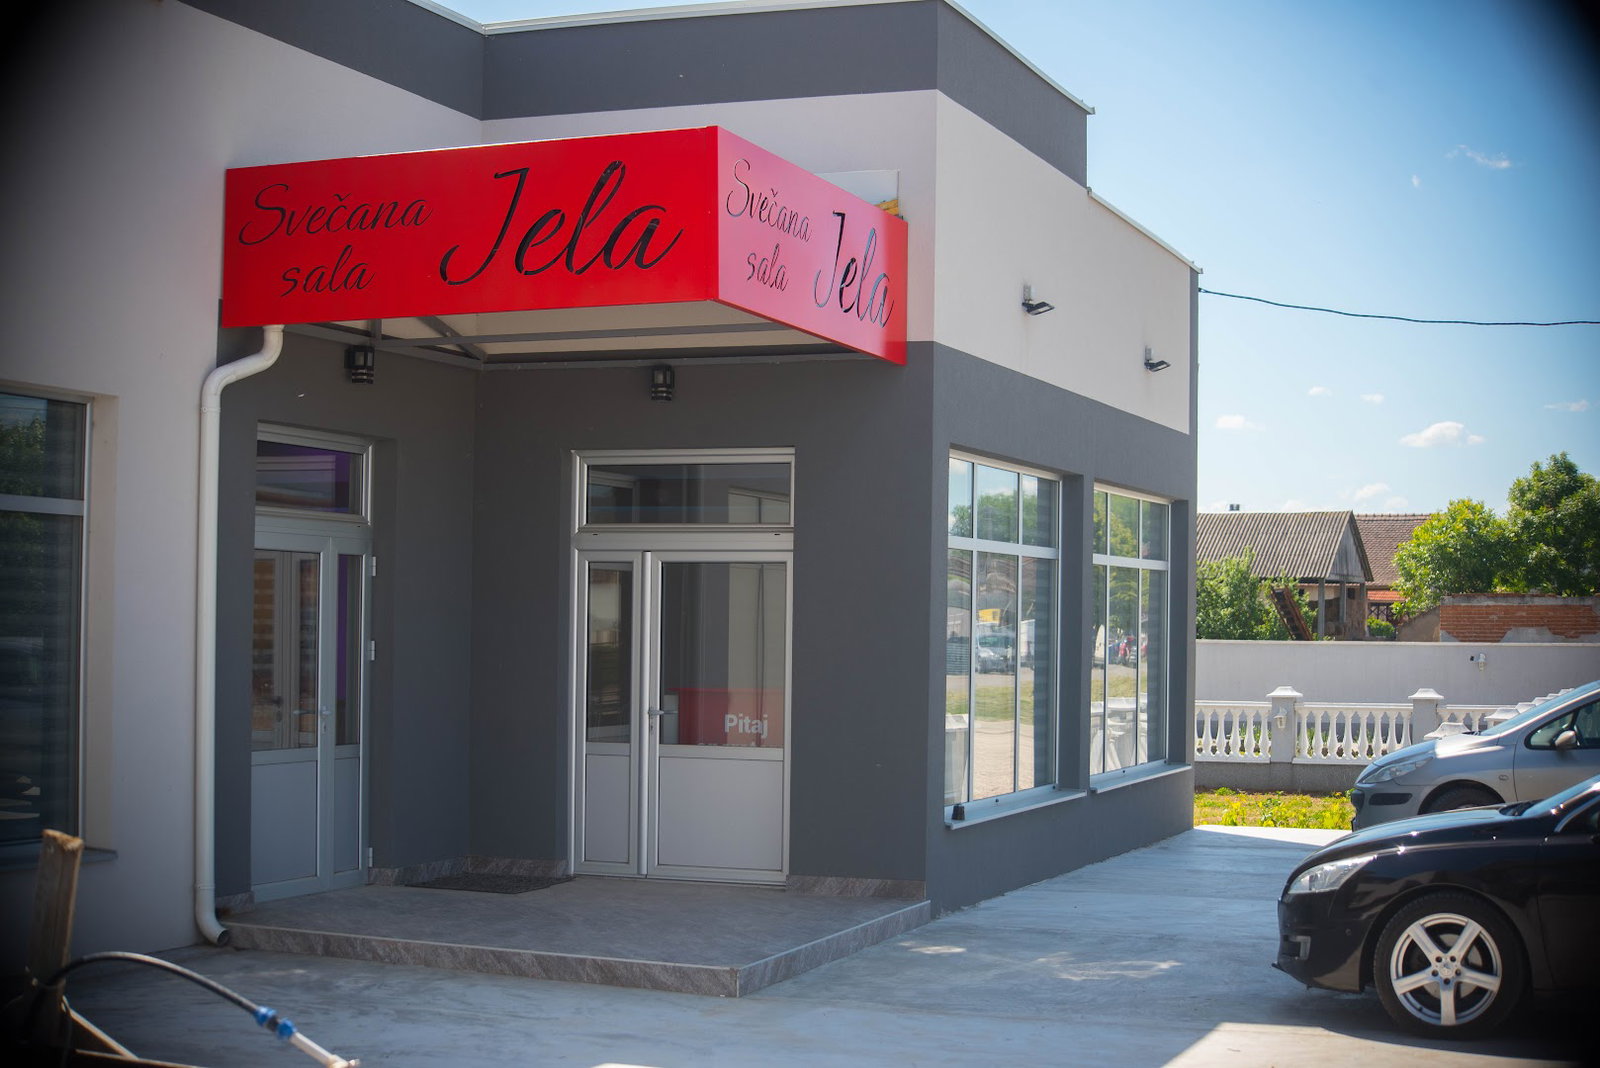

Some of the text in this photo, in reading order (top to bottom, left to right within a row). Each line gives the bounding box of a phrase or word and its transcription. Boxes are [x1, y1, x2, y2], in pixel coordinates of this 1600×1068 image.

[238, 183, 433, 246] Svečana
[438, 160, 684, 285] Jela
[726, 158, 813, 243] Svečana
[280, 244, 375, 297] sala
[747, 243, 790, 292] sala
[813, 210, 895, 328] Jela
[724, 713, 769, 739] Pitaj
